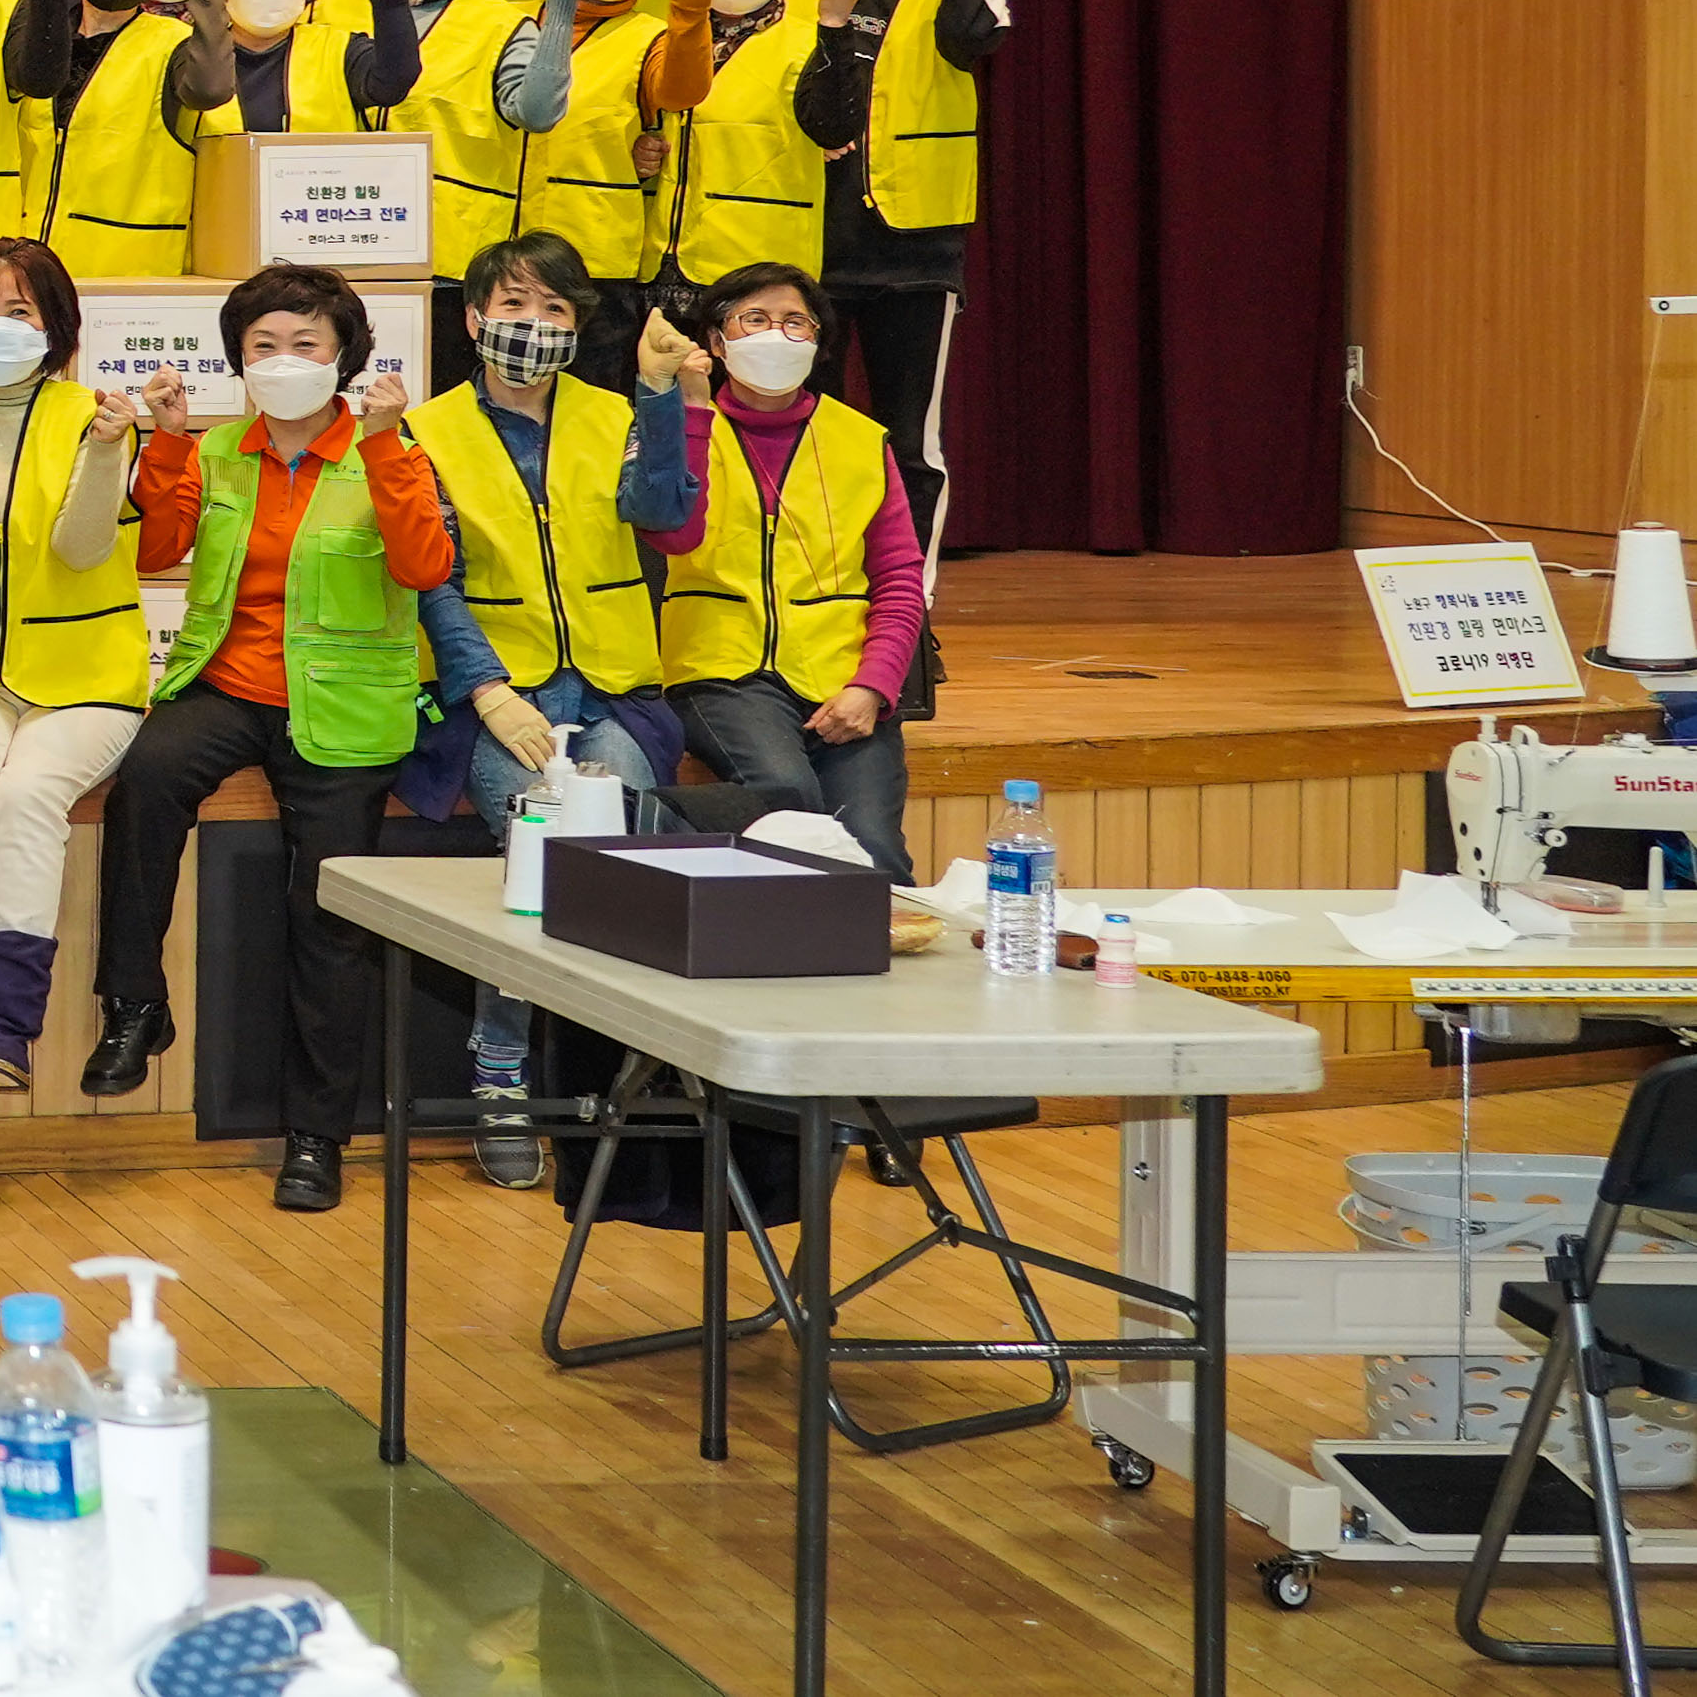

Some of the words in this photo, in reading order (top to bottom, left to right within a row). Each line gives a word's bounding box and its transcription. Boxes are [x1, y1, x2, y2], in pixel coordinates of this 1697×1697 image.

[306, 186, 346, 200] 친환경
[354, 186, 380, 200] 힐링
[280, 208, 308, 223] 수제
[316, 207, 372, 223] 면마스크
[379, 206, 407, 222] 전달
[308, 234, 345, 244] 면마스크
[351, 233, 379, 244] 의병단
[124, 336, 165, 351] 친환경
[172, 336, 199, 351] 힐링
[97, 358, 126, 374] 수제
[196, 358, 226, 374] 전달
[375, 358, 404, 373] 전달
[1484, 590, 1528, 606] 프로젝트
[1407, 620, 1452, 642] 친환경
[1457, 618, 1486, 639] 힐링
[1491, 615, 1547, 637] 면마스크
[1436, 653, 1490, 673] 코로나19
[1495, 650, 1536, 670] 의병단
